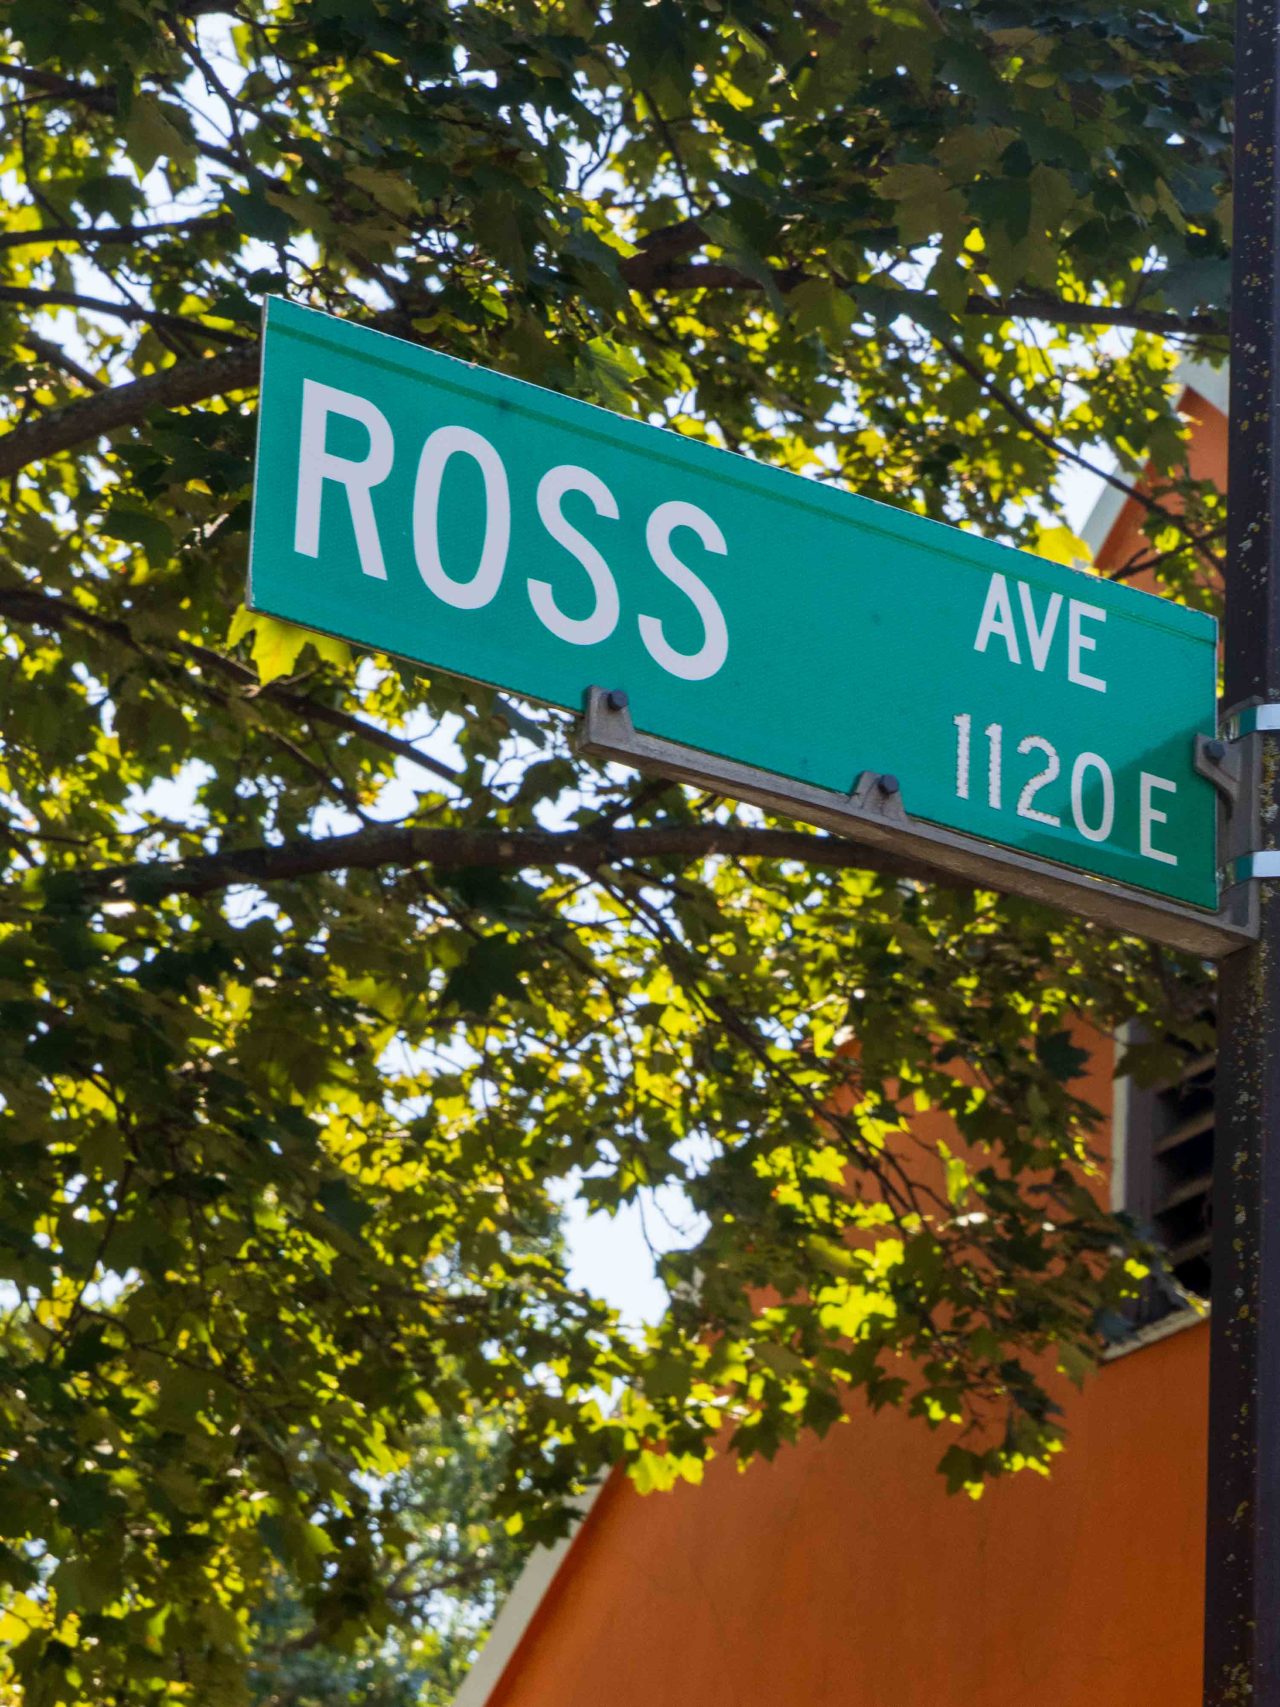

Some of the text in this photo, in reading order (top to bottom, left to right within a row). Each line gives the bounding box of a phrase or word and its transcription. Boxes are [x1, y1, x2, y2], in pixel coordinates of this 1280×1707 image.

[293, 377, 730, 682] ROSS
[973, 571, 1108, 694] AVE
[952, 712, 1179, 867] 1120 E
